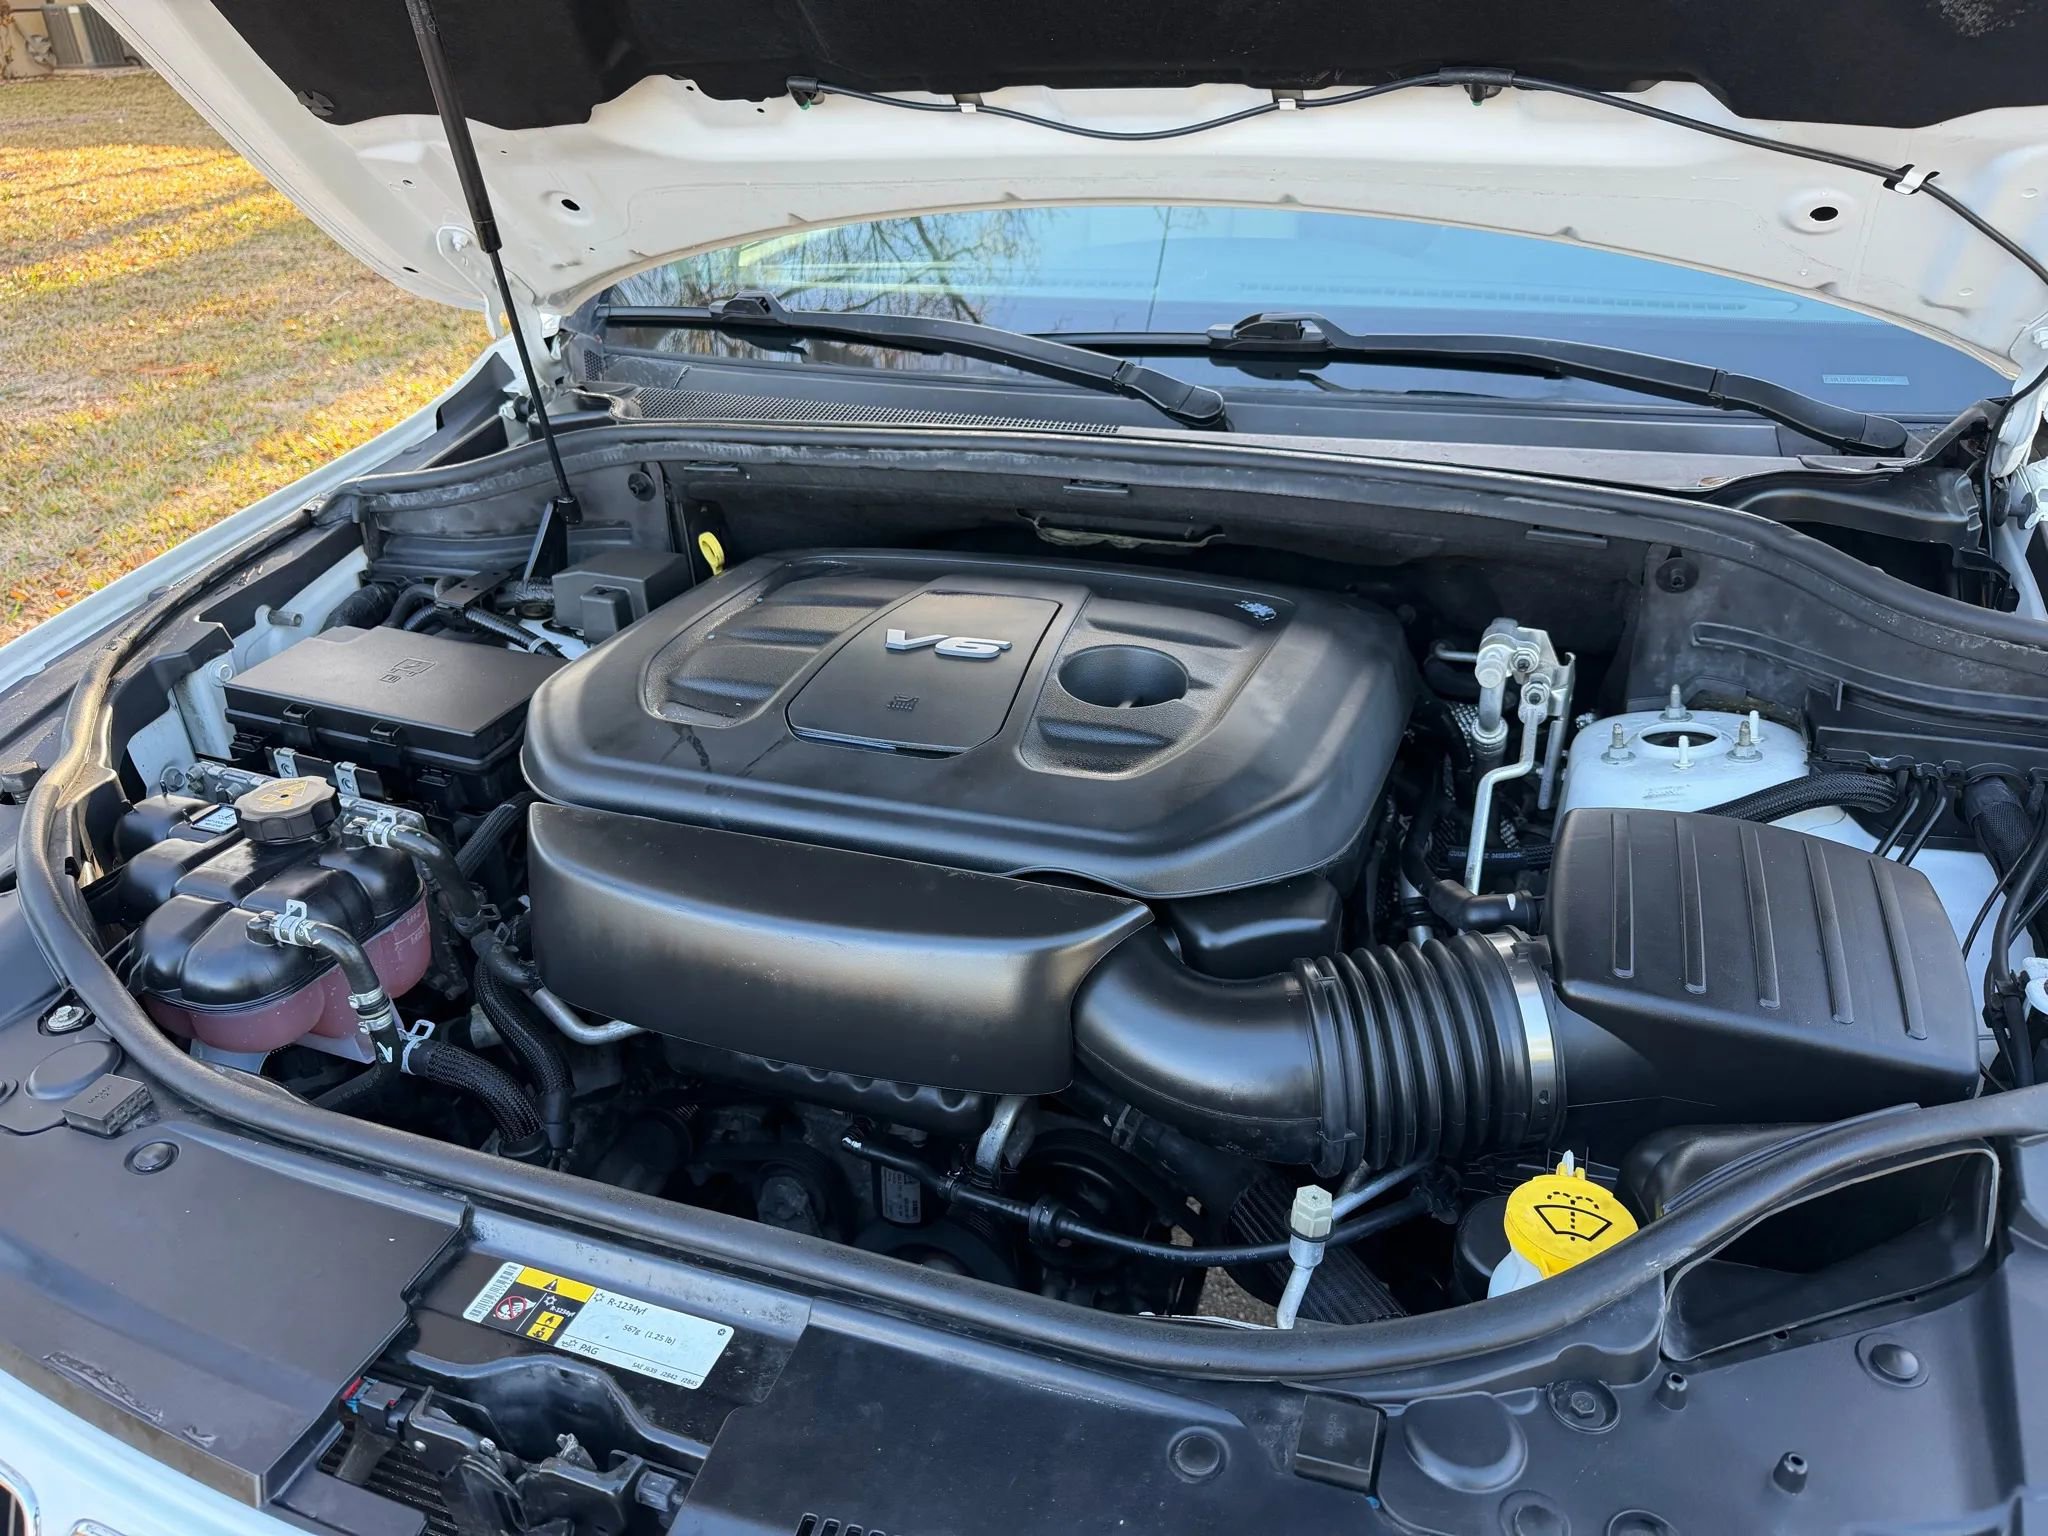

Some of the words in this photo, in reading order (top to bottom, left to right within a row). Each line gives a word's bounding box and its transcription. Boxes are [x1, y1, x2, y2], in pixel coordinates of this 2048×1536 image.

[885, 628, 1013, 659] V6
[607, 1297, 648, 1316] R-1234yf
[622, 1324, 641, 1336] 567g
[644, 1331, 665, 1342] (1.25
[578, 1343, 600, 1355] PAG
[631, 1362, 645, 1370] SAE
